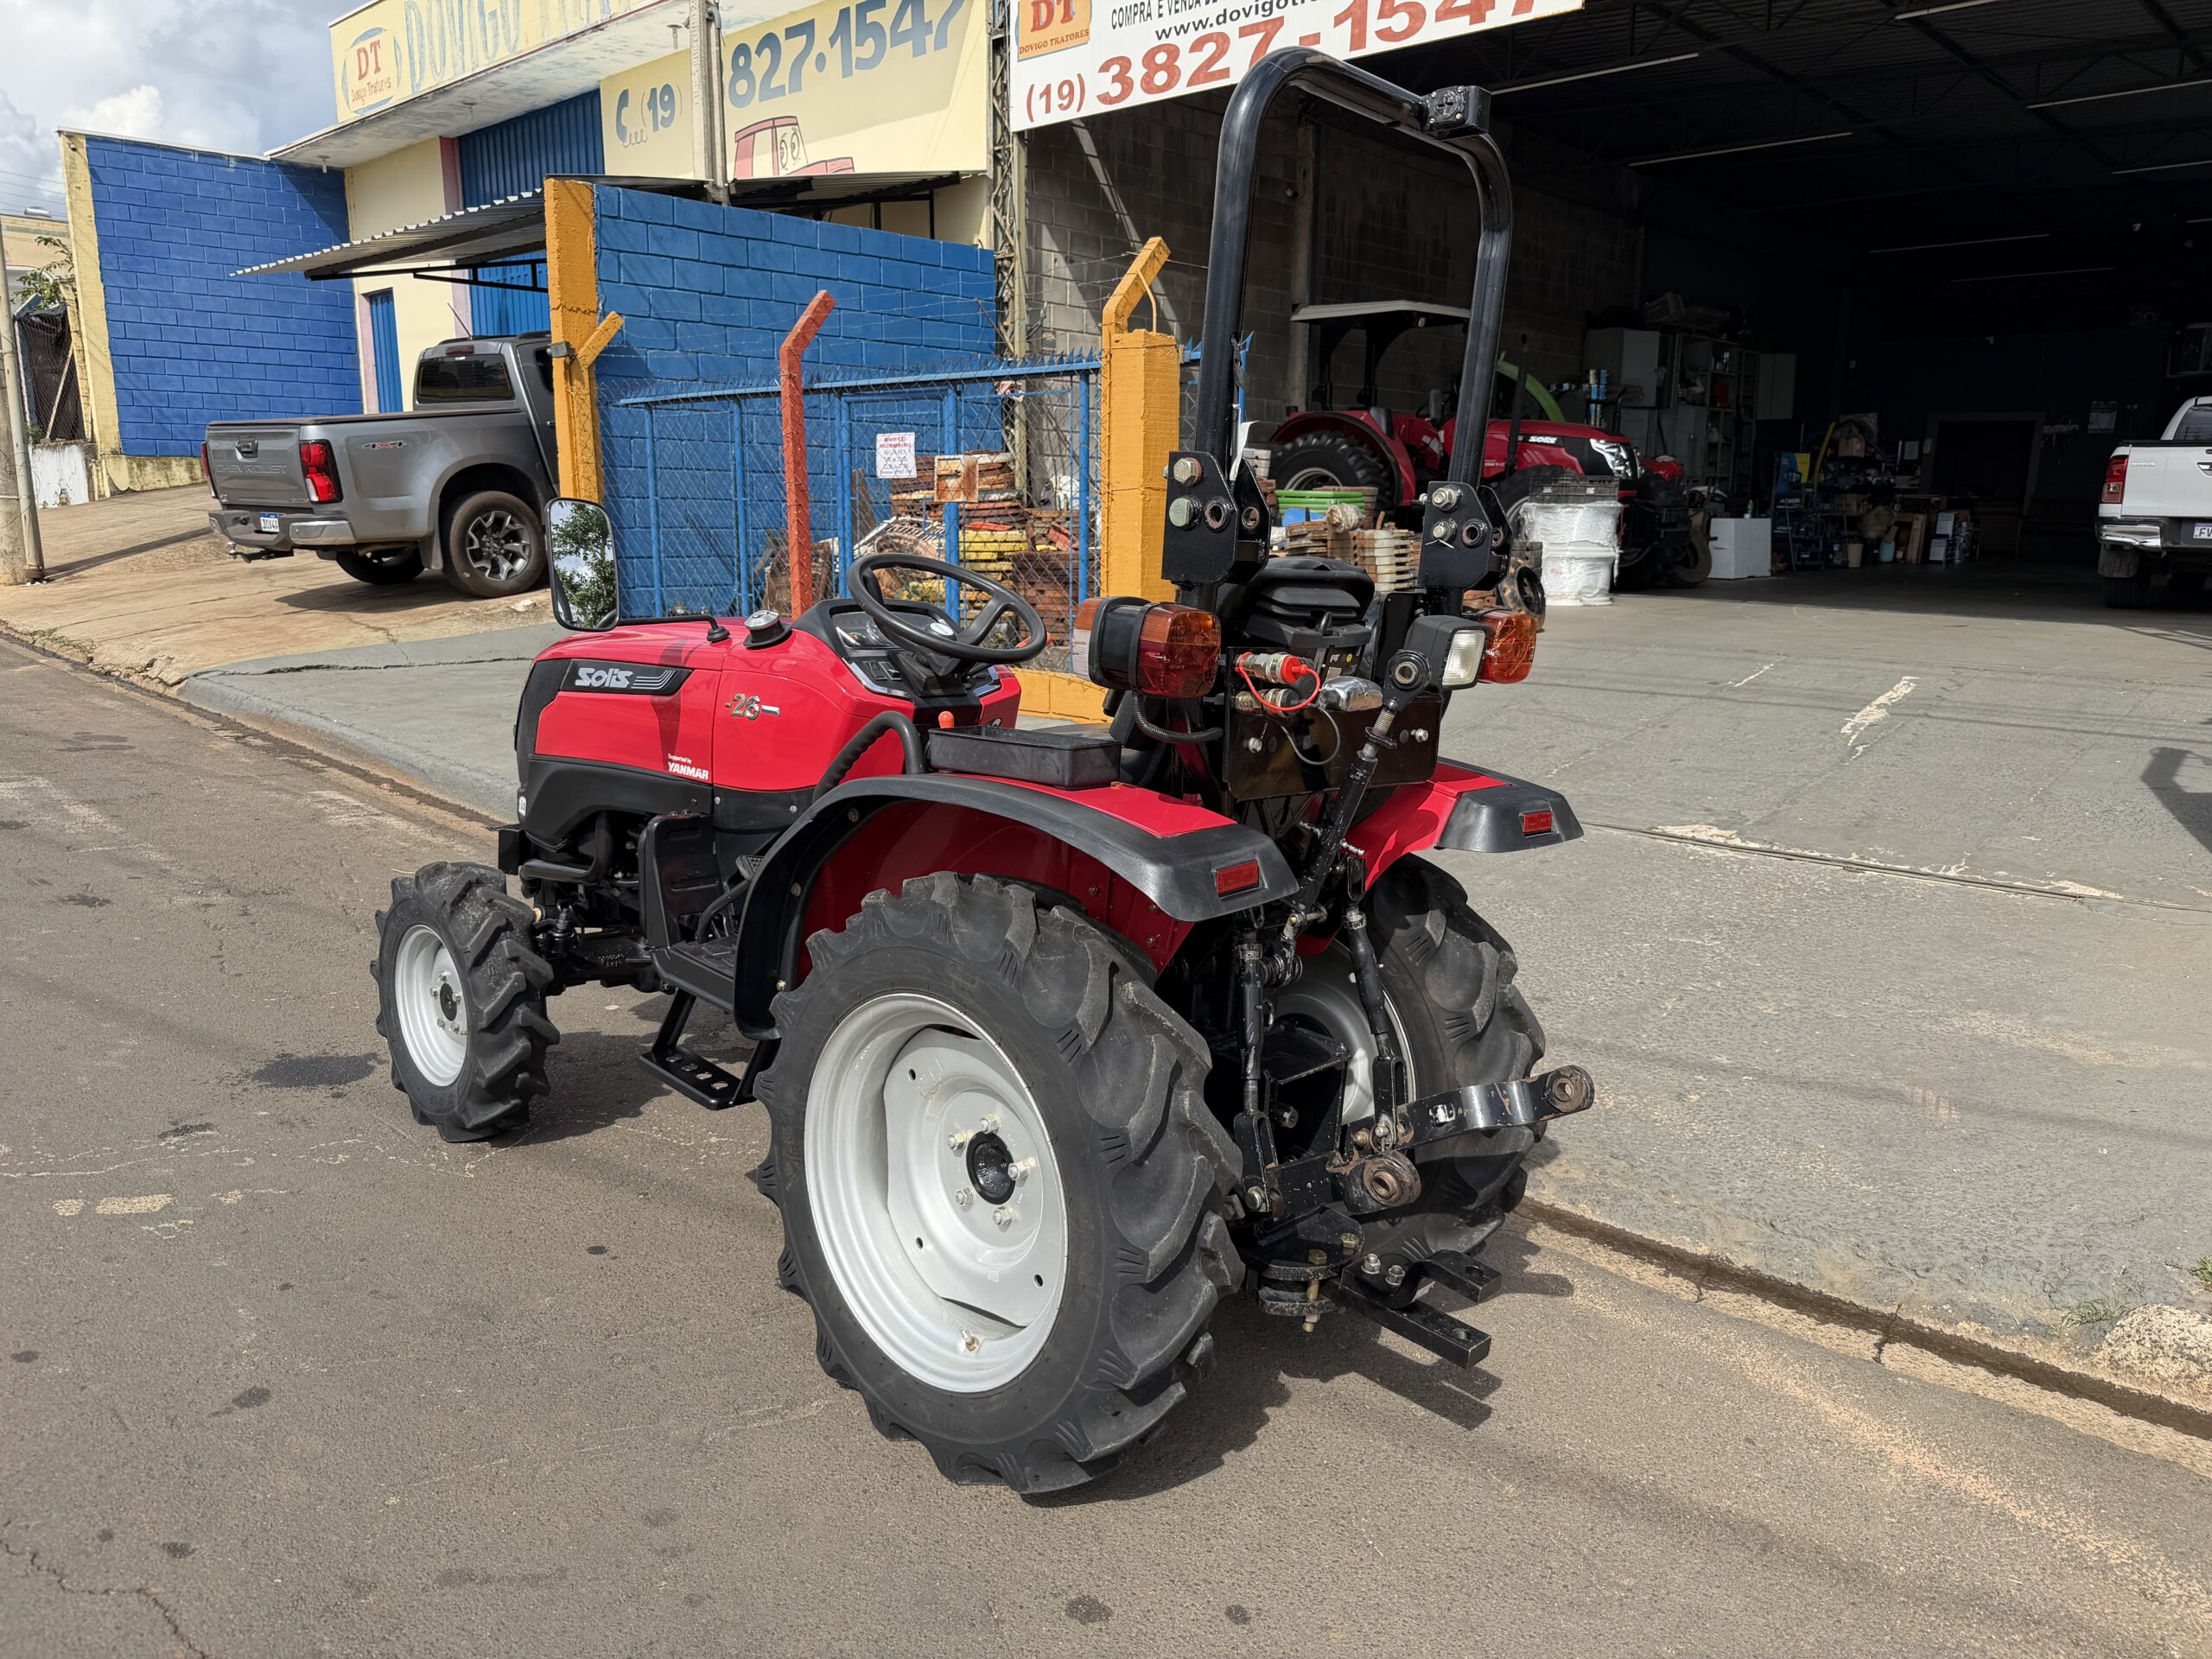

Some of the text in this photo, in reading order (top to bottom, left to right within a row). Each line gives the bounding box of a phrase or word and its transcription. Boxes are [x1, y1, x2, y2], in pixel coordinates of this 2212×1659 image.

[1031, 0, 1076, 33] DT
[1111, 0, 1153, 30] COMPRA
[1020, 29, 1089, 54] DOVIGO TRATORES
[356, 39, 381, 81] DT
[641, 83, 682, 132] (19)
[1027, 73, 1086, 123] (19)
[731, 692, 760, 721] 26
[668, 761, 709, 780] YANMAR
